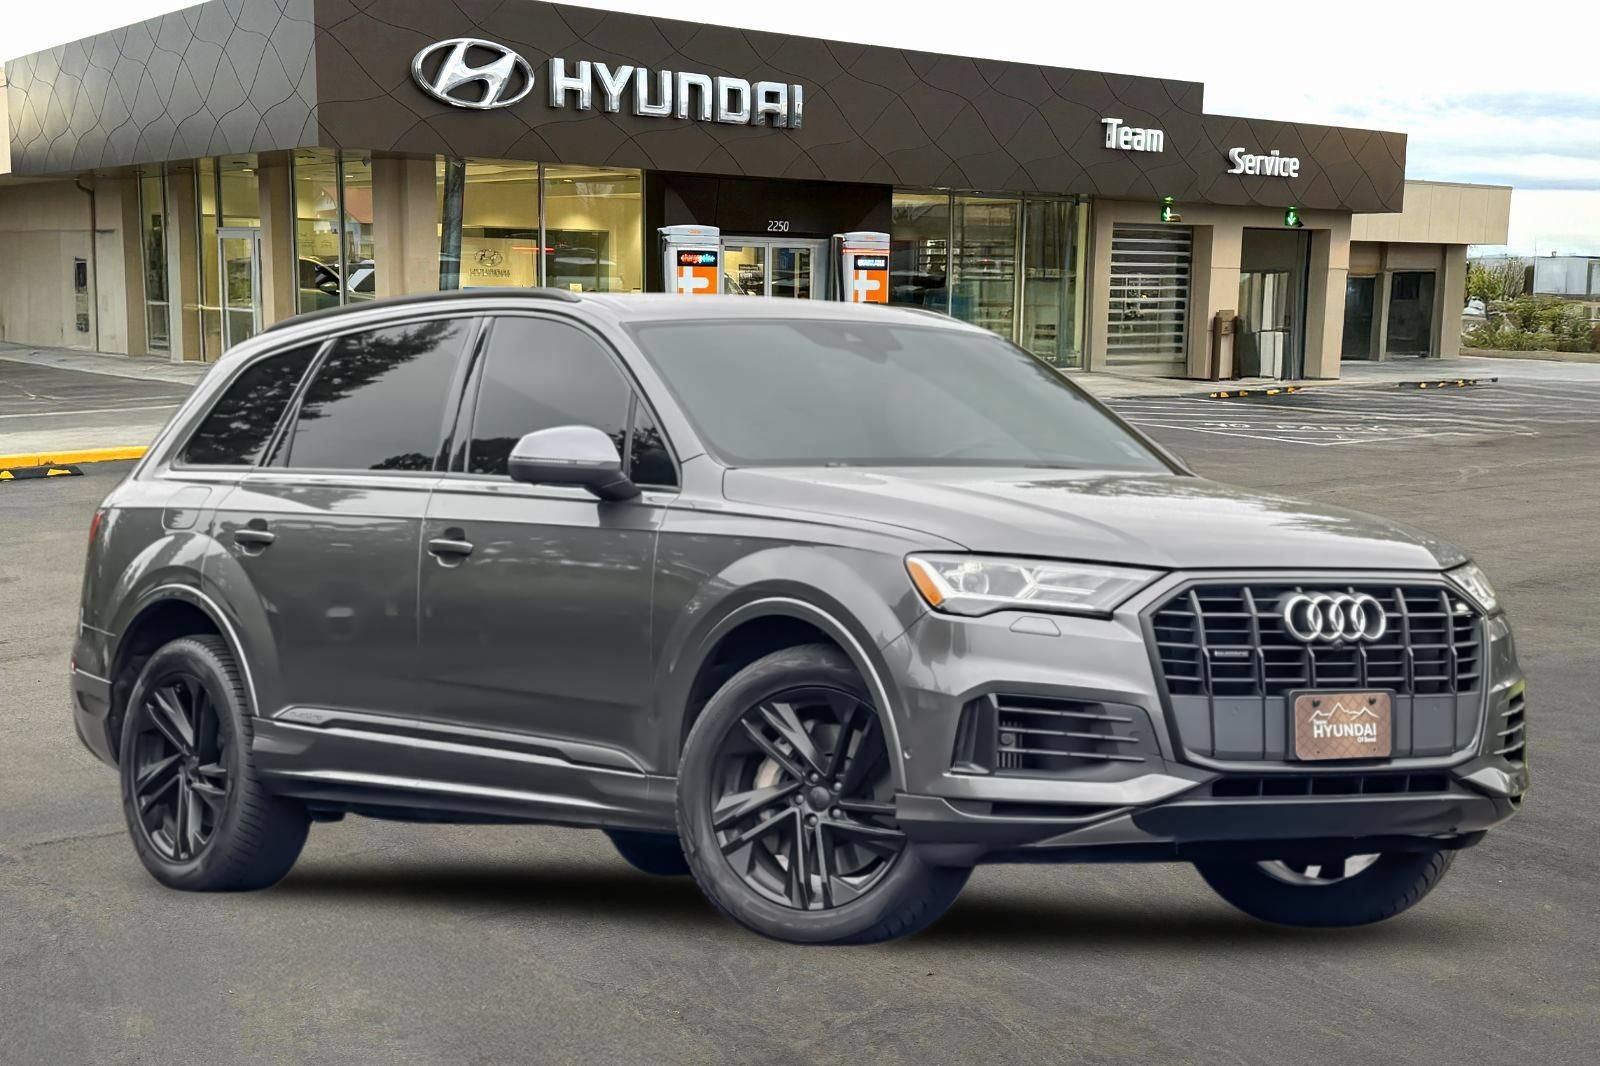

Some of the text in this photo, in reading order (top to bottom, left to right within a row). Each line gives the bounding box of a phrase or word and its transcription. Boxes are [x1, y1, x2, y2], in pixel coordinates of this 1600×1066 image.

[548, 57, 803, 129] HYUNDAI
[1101, 117, 1164, 153] Team
[1227, 147, 1300, 178] Service
[767, 220, 790, 232] 2250
[1313, 722, 1377, 739] HYUNDAI
